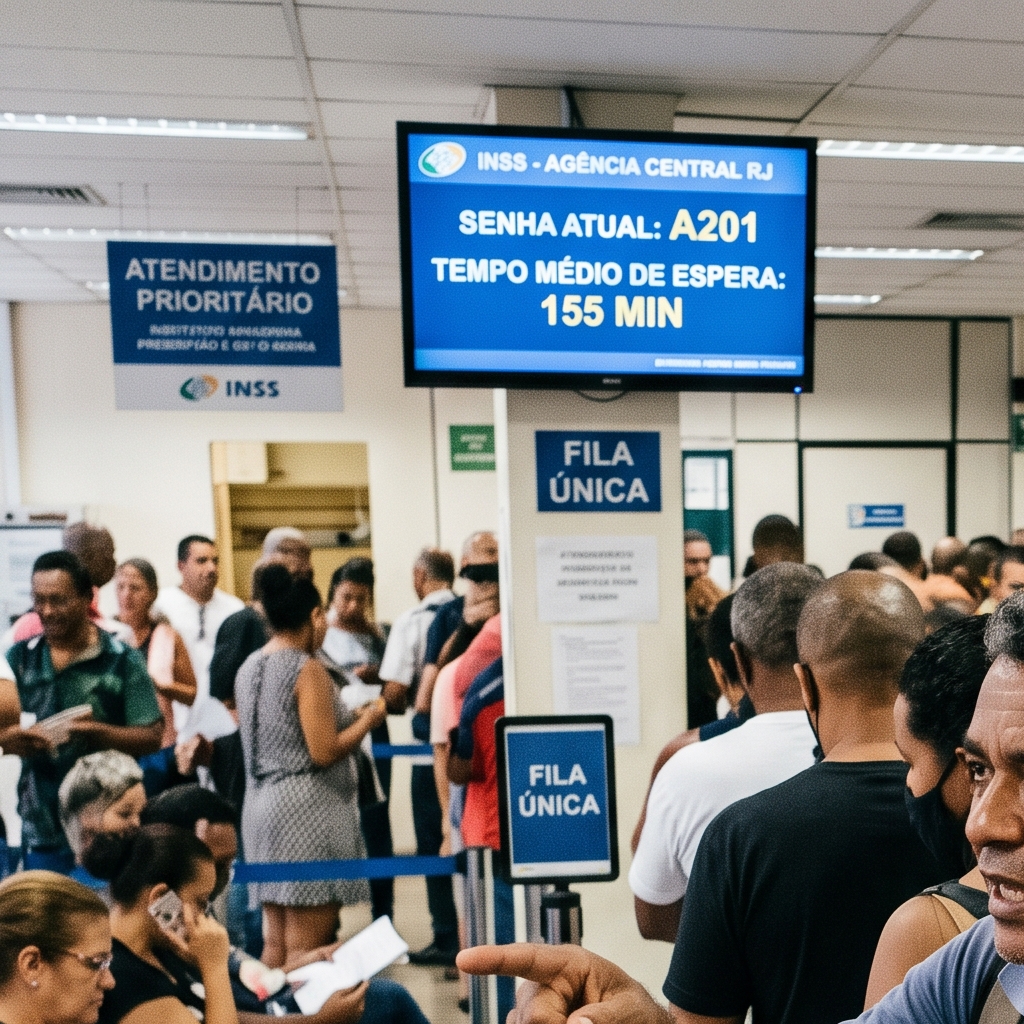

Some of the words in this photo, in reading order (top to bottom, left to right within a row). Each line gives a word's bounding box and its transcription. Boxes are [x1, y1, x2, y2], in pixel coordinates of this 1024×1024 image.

[477, 151, 528, 173] INSS
[544, 151, 641, 176] AGÊNCIA
[644, 157, 743, 181] CENTRAL
[746, 161, 774, 181] RJ
[458, 209, 558, 238] SENHA
[561, 213, 662, 240] ATUAL:
[668, 208, 757, 243] A201
[125, 257, 321, 285] ATENDIMENTO
[430, 256, 529, 284] TEMPO
[535, 254, 623, 287] MÉDIO
[628, 262, 666, 287] DE
[672, 263, 786, 290] ESPERA:
[136, 285, 314, 315] PRIORITÁRIO
[540, 293, 605, 327] 155
[614, 295, 683, 329] MIN
[226, 380, 280, 398] INSS
[563, 440, 635, 467] FILA
[549, 470, 650, 504] ÚNICA
[529, 763, 588, 787] FILA
[518, 789, 602, 818] ÚNICA
